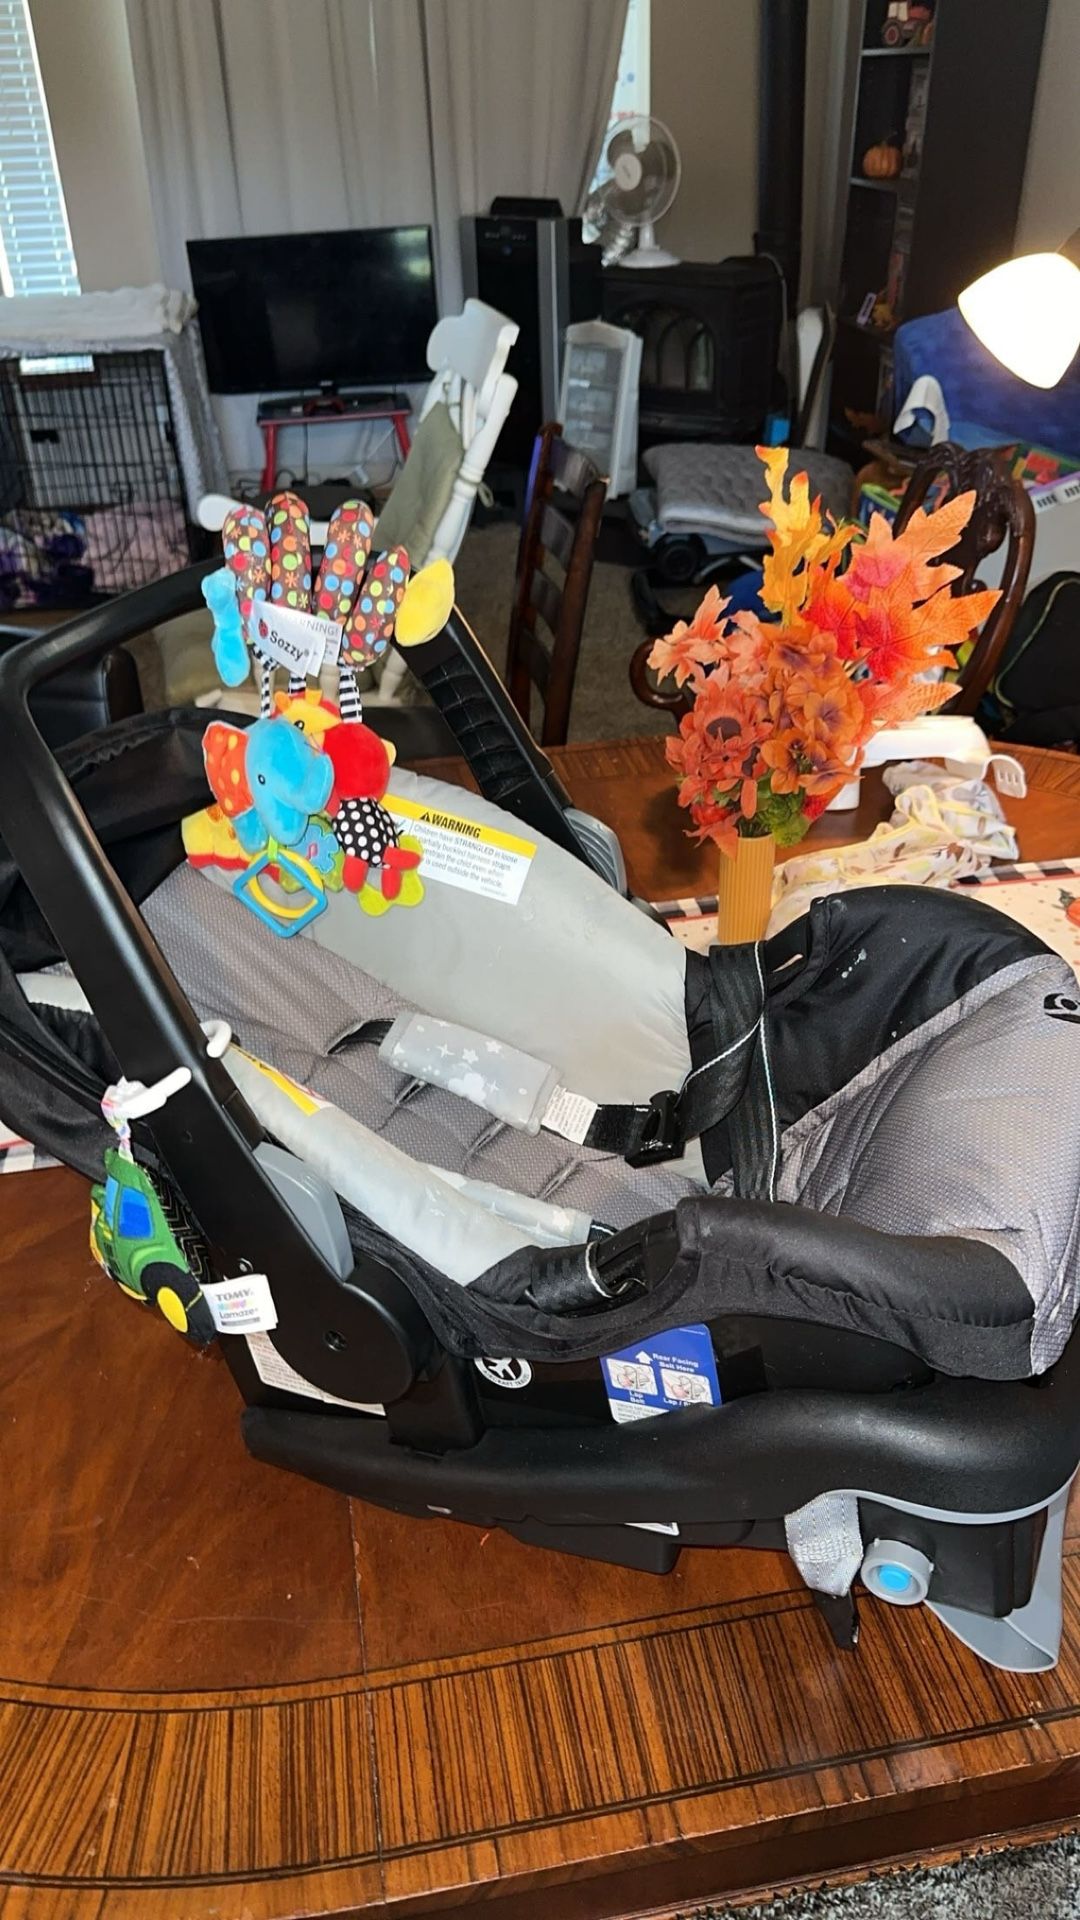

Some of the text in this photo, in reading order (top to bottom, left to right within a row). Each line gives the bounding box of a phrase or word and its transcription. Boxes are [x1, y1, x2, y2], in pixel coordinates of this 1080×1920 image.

[269, 630, 304, 662] Sozzy
[432, 813, 481, 839] WARNING
[414, 823, 439, 840] Children
[439, 832, 454, 844] have
[454, 836, 494, 855] STRANGLED
[500, 852, 518, 864] loose
[442, 843, 466, 857] buckled
[431, 860, 447, 871] used
[447, 865, 470, 878] outside
[469, 870, 480, 880] the
[456, 857, 472, 869] child
[215, 1288, 251, 1302] TOMY
[219, 1308, 255, 1320] Lamaze
[652, 1352, 699, 1368] Rear Facing
[659, 1361, 695, 1372] Belt Here
[629, 1390, 643, 1399] Lap
[663, 1397, 678, 1406] Lap
